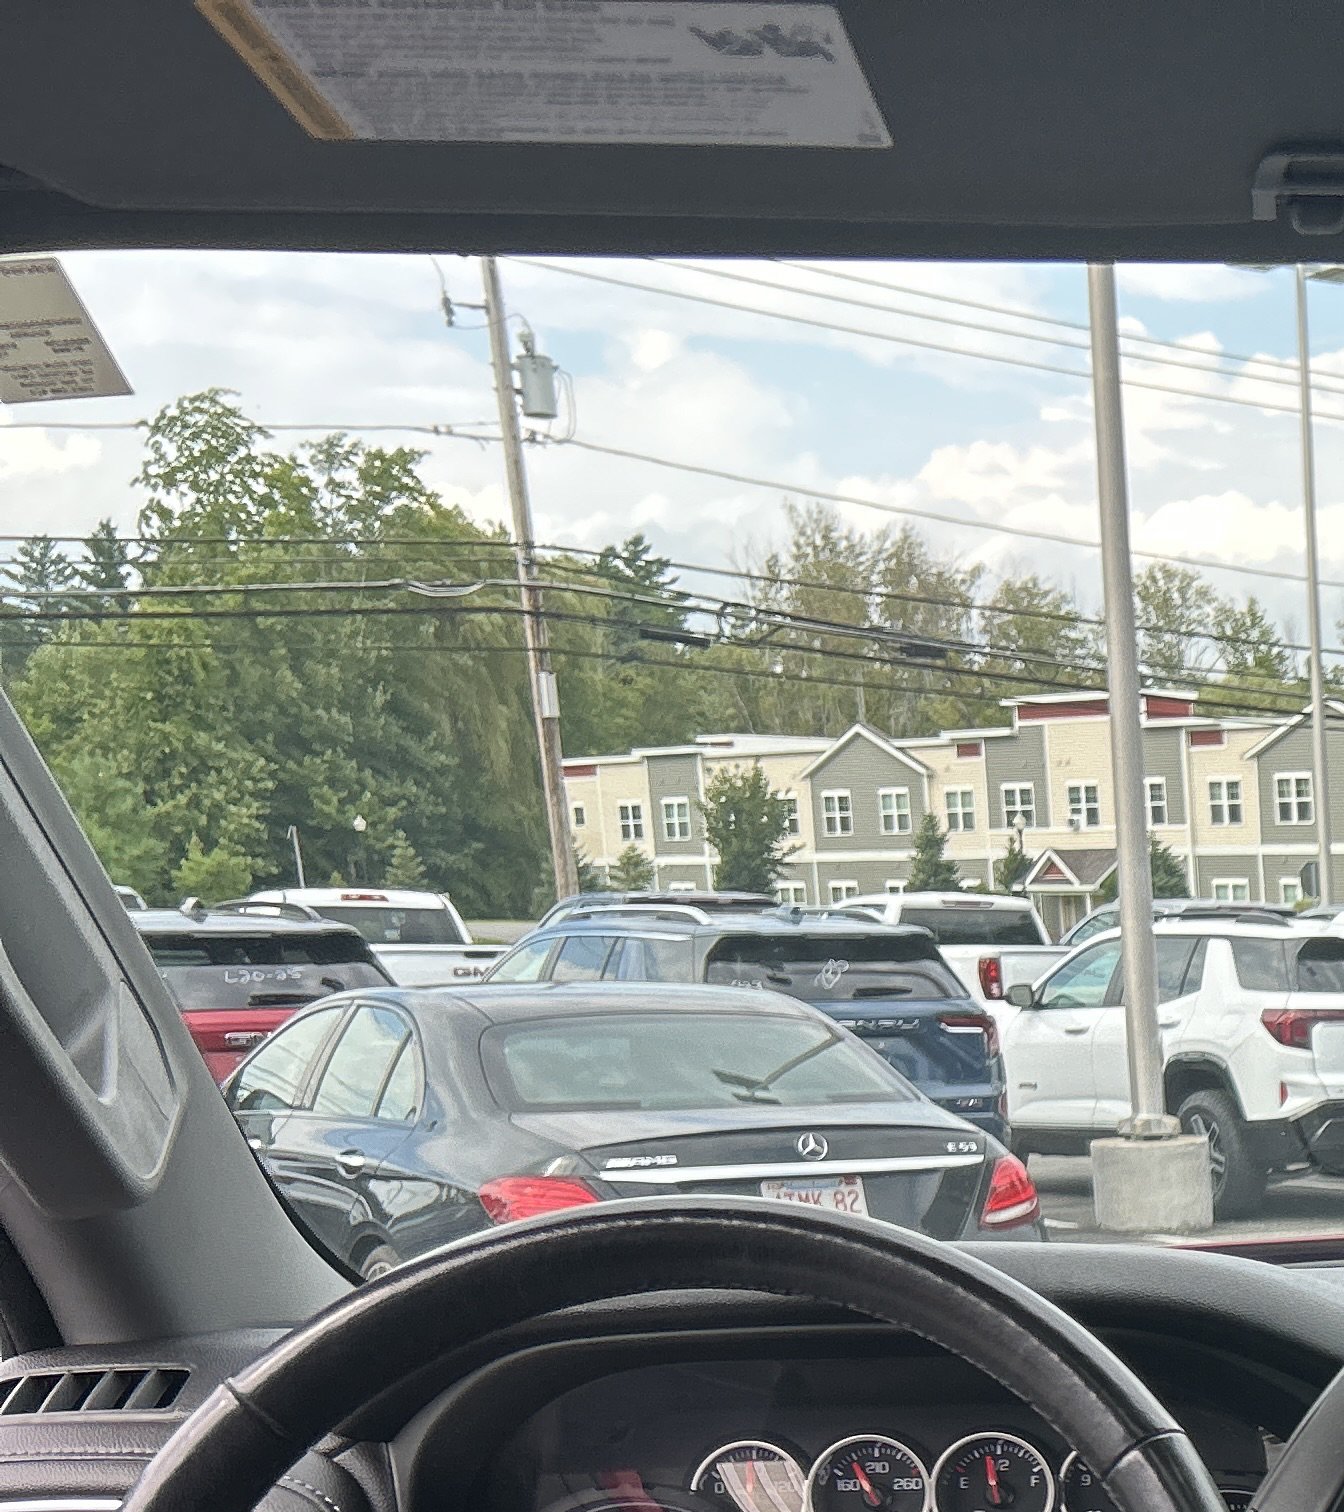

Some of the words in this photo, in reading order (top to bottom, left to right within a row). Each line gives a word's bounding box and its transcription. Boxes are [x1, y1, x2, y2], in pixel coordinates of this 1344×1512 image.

[865, 1461, 890, 1474] 210
[837, 1479, 860, 1491] 160
[893, 1477, 923, 1491] 260
[959, 1476, 969, 1489] E
[1030, 1475, 1040, 1488] F
[1080, 1474, 1091, 1487] 9
